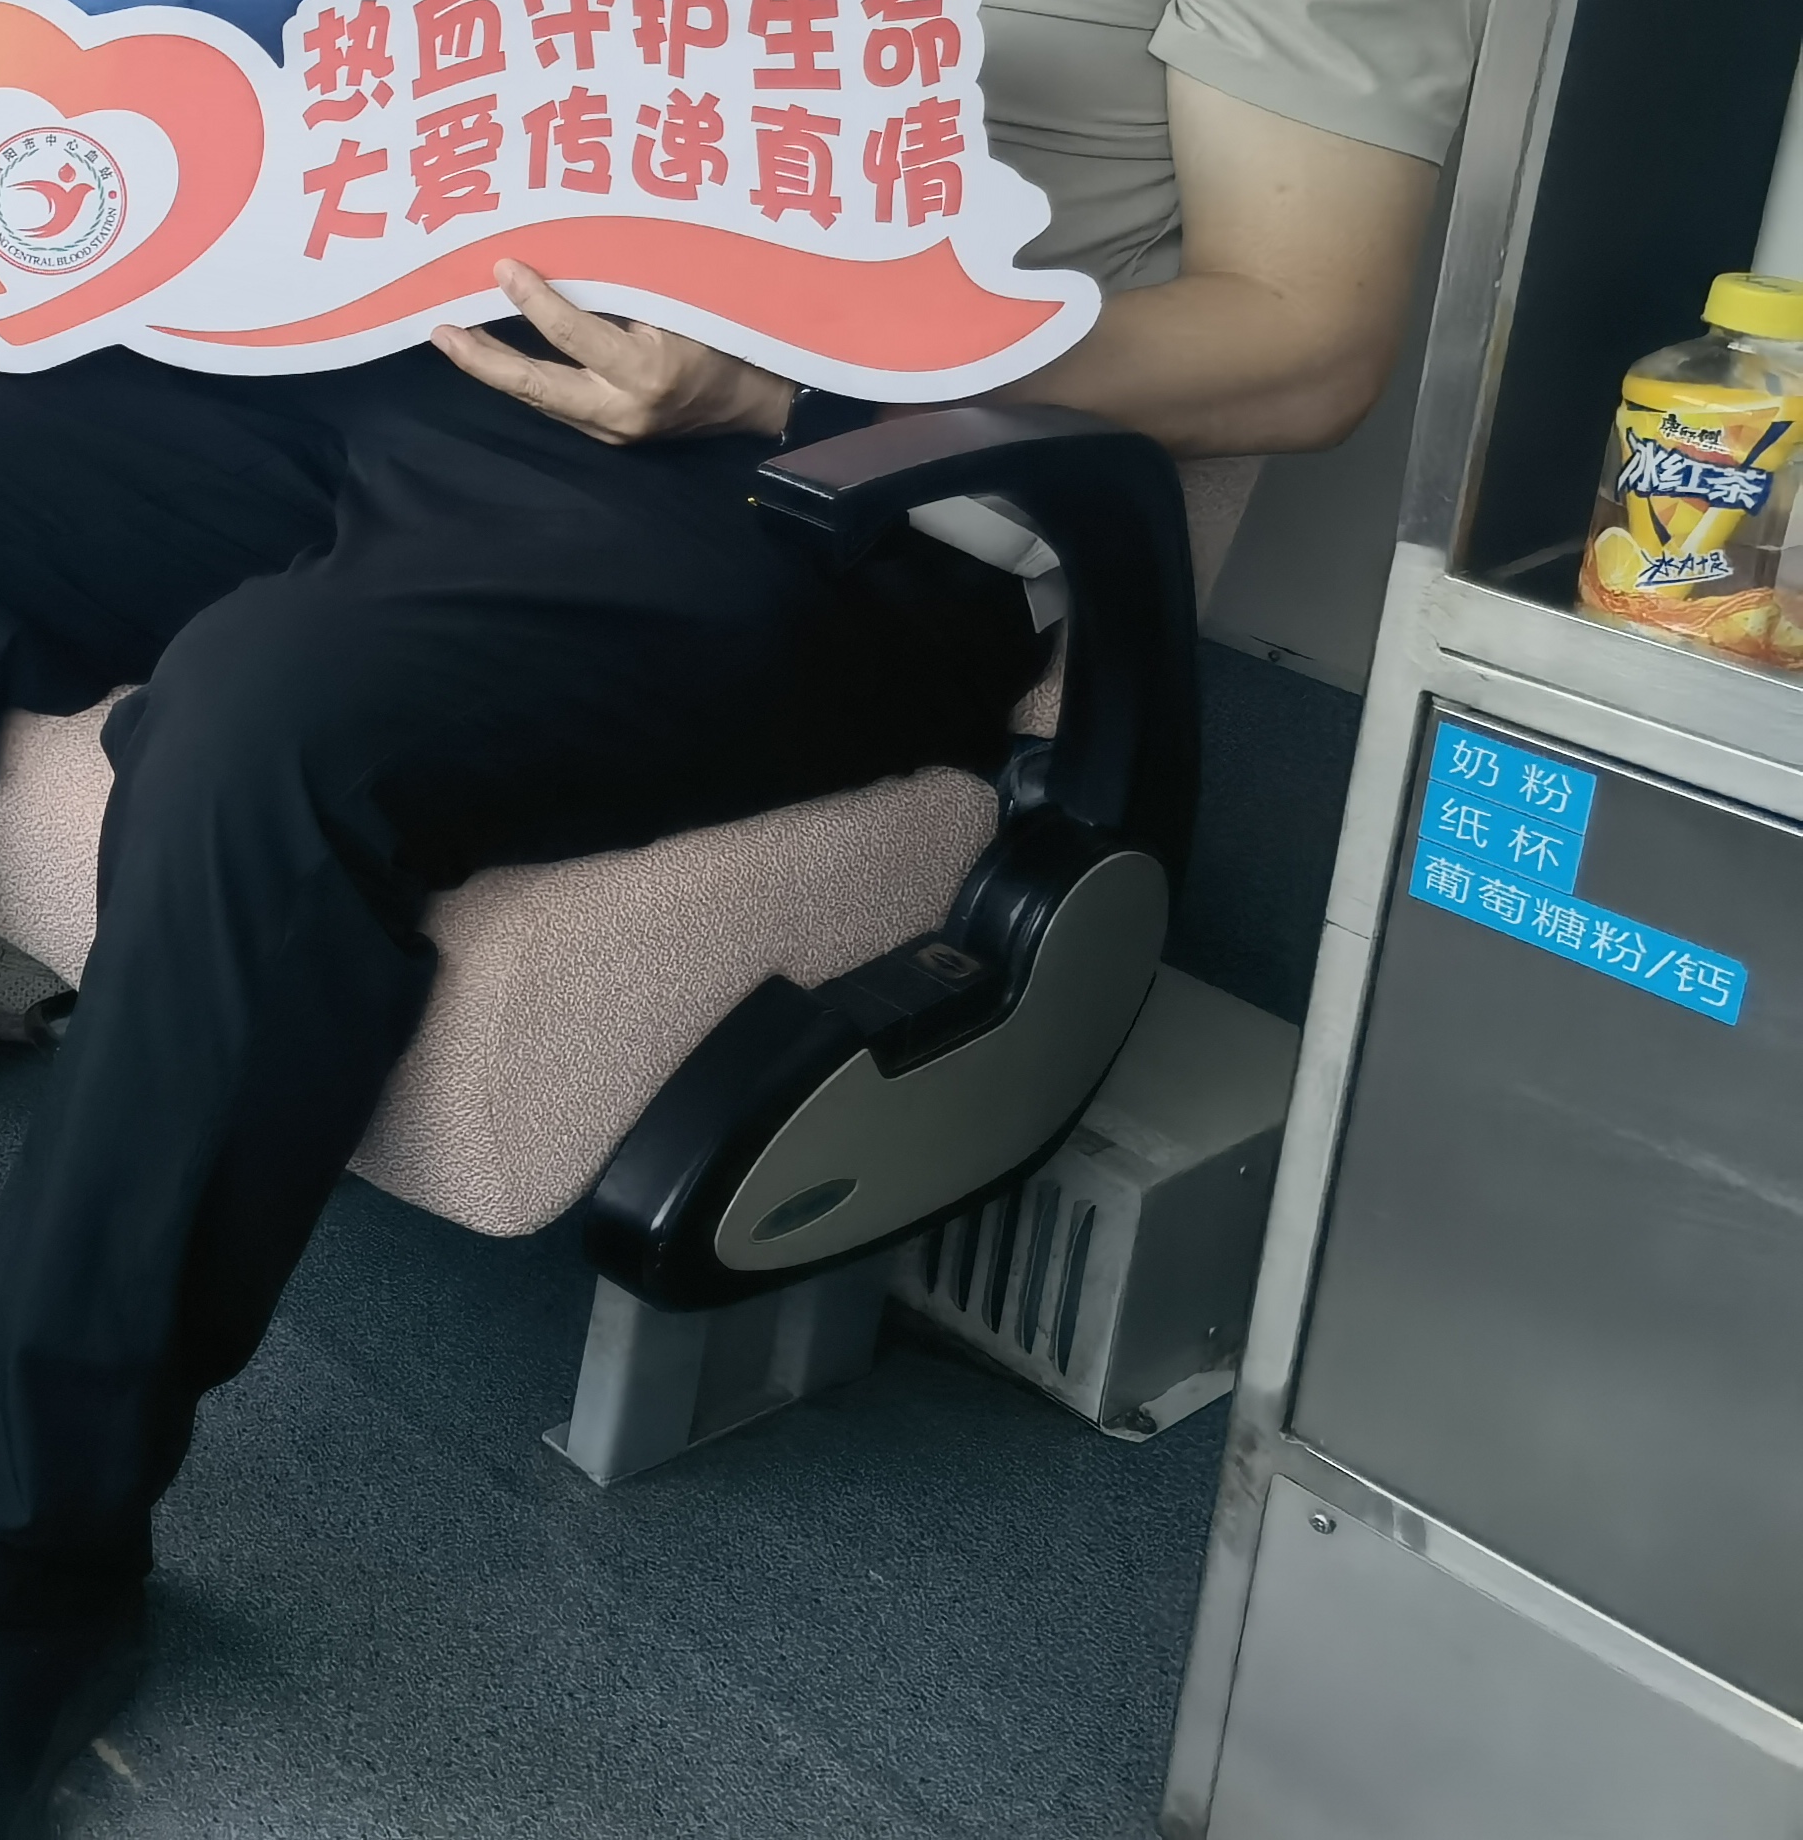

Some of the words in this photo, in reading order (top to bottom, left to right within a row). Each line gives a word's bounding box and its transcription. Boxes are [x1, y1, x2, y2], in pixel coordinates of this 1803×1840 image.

[303, 85, 965, 259] 大爱传递真情
[7, 243, 55, 267] CENTRAL
[55, 245, 93, 267] BLOOD
[90, 206, 117, 250] STATION
[1617, 429, 1766, 512] 冰红茶
[1448, 738, 1573, 814] 奶粉
[1437, 796, 1564, 872] 纸杯
[1424, 853, 1736, 1008] 葡萄糖粉/钙
